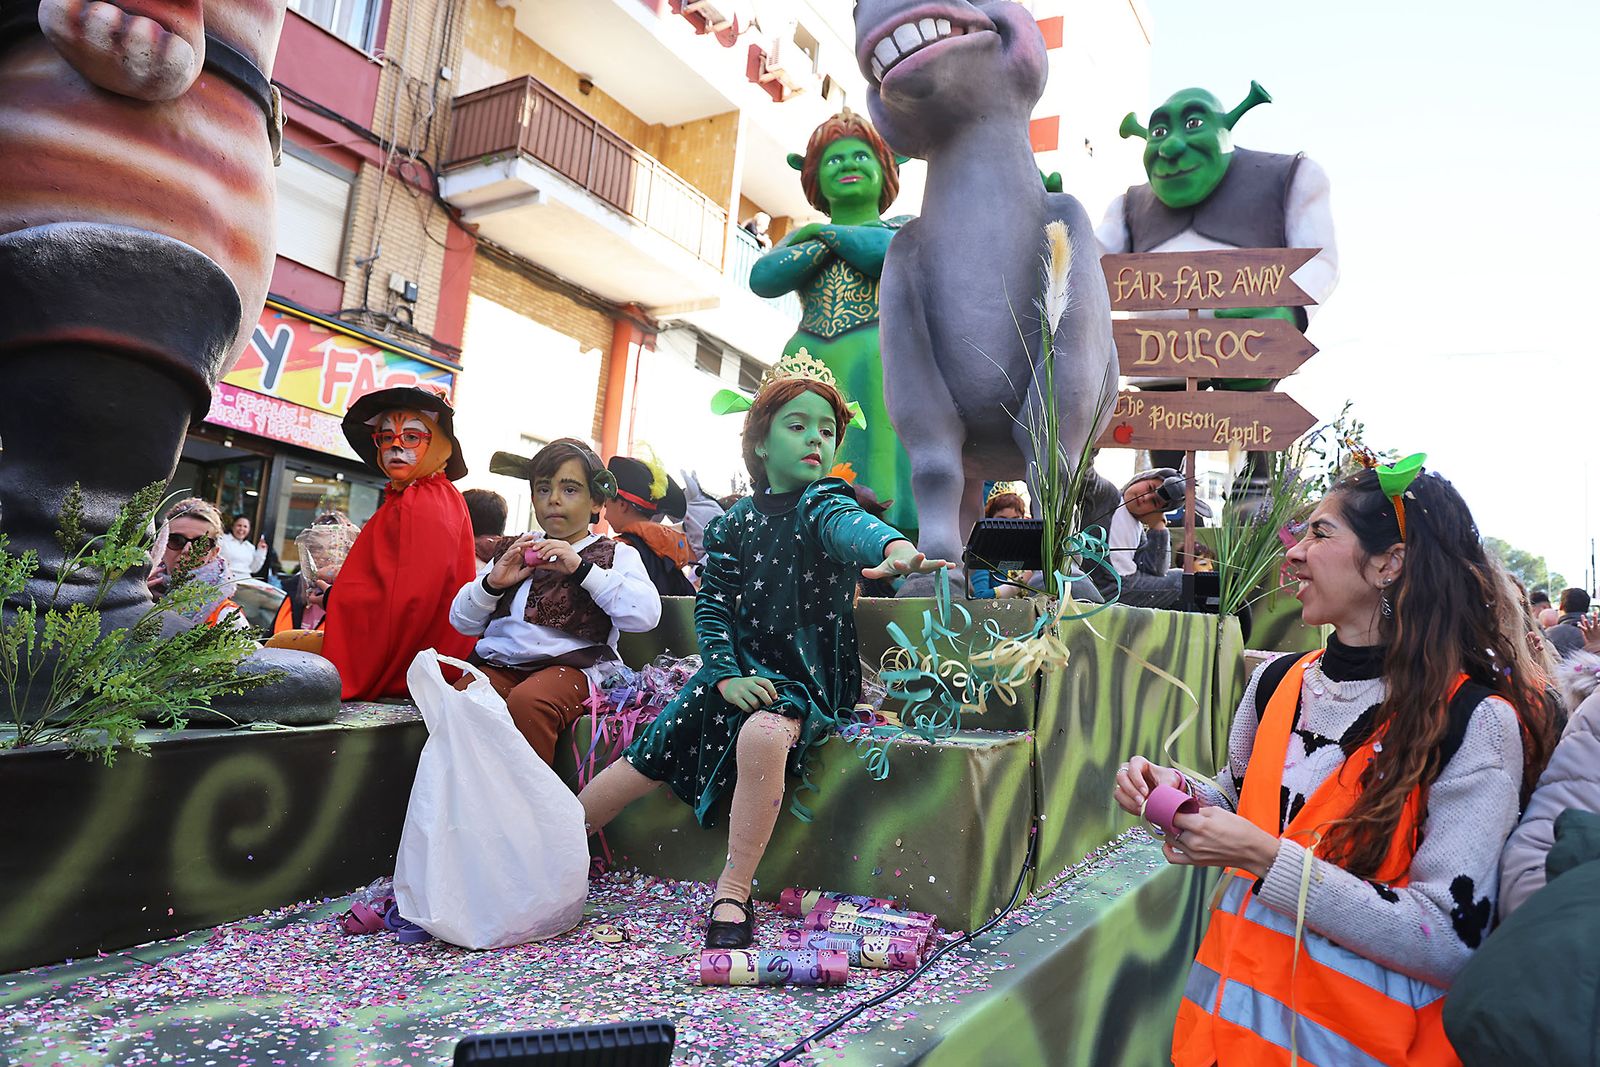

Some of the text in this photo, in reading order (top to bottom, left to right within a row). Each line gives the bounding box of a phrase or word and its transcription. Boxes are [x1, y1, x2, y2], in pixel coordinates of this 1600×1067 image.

[1230, 264, 1286, 296] AWAY
[1133, 328, 1265, 368] DULOC
[236, 392, 298, 423] REGALOS
[1112, 394, 1144, 417] The
[1149, 404, 1273, 447] Poison Apple
